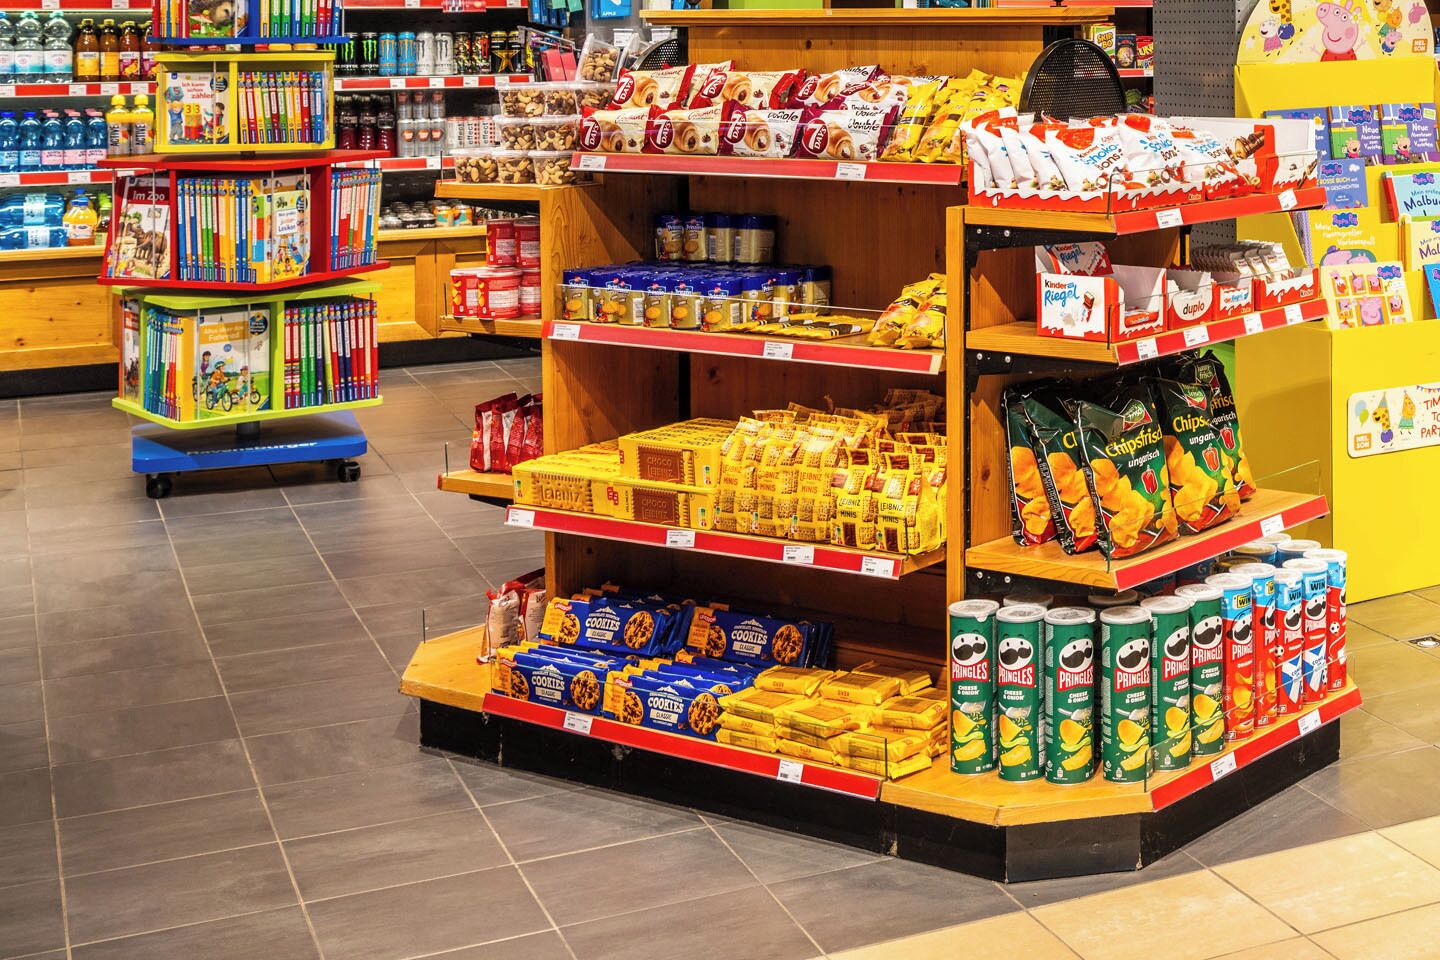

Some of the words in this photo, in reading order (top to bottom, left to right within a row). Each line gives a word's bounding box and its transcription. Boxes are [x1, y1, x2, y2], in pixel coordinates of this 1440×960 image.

[1102, 40, 1114, 49] BO
[620, 78, 635, 100] DAYS
[709, 74, 725, 95] DAYS
[136, 123, 146, 146] ACTIVE
[589, 123, 600, 147] DAYS
[661, 120, 672, 145] DAYS
[732, 114, 745, 140] DAYS
[1362, 126, 1379, 135] Neue
[1411, 123, 1429, 132] Neue
[110, 124, 120, 147] ACTIVE
[814, 125, 828, 150] DAYS
[132, 191, 144, 201] Im
[146, 191, 166, 201] Zoo
[1060, 246, 1084, 263] Riegel
[1044, 279, 1067, 289] kinder
[1044, 288, 1080, 307] Riegel
[1182, 300, 1205, 316] duplo
[647, 456, 672, 467] CHOCO
[1128, 448, 1160, 468] ungarisch
[641, 498, 667, 508] CHOCO
[839, 496, 861, 507] LEIBNIZ
[880, 502, 904, 512] LEIBNIZ
[840, 510, 857, 519] MINIS
[882, 515, 900, 524] MINIS
[1310, 581, 1326, 592] WIN
[585, 618, 621, 632] COOKIES
[731, 630, 769, 646] COOKIES
[951, 660, 988, 681] PRINGLES
[998, 665, 1033, 686] PRINGLES
[531, 676, 565, 691] COOKIES
[1059, 668, 1094, 690] PRINGLES
[647, 697, 685, 713] COOKIES
